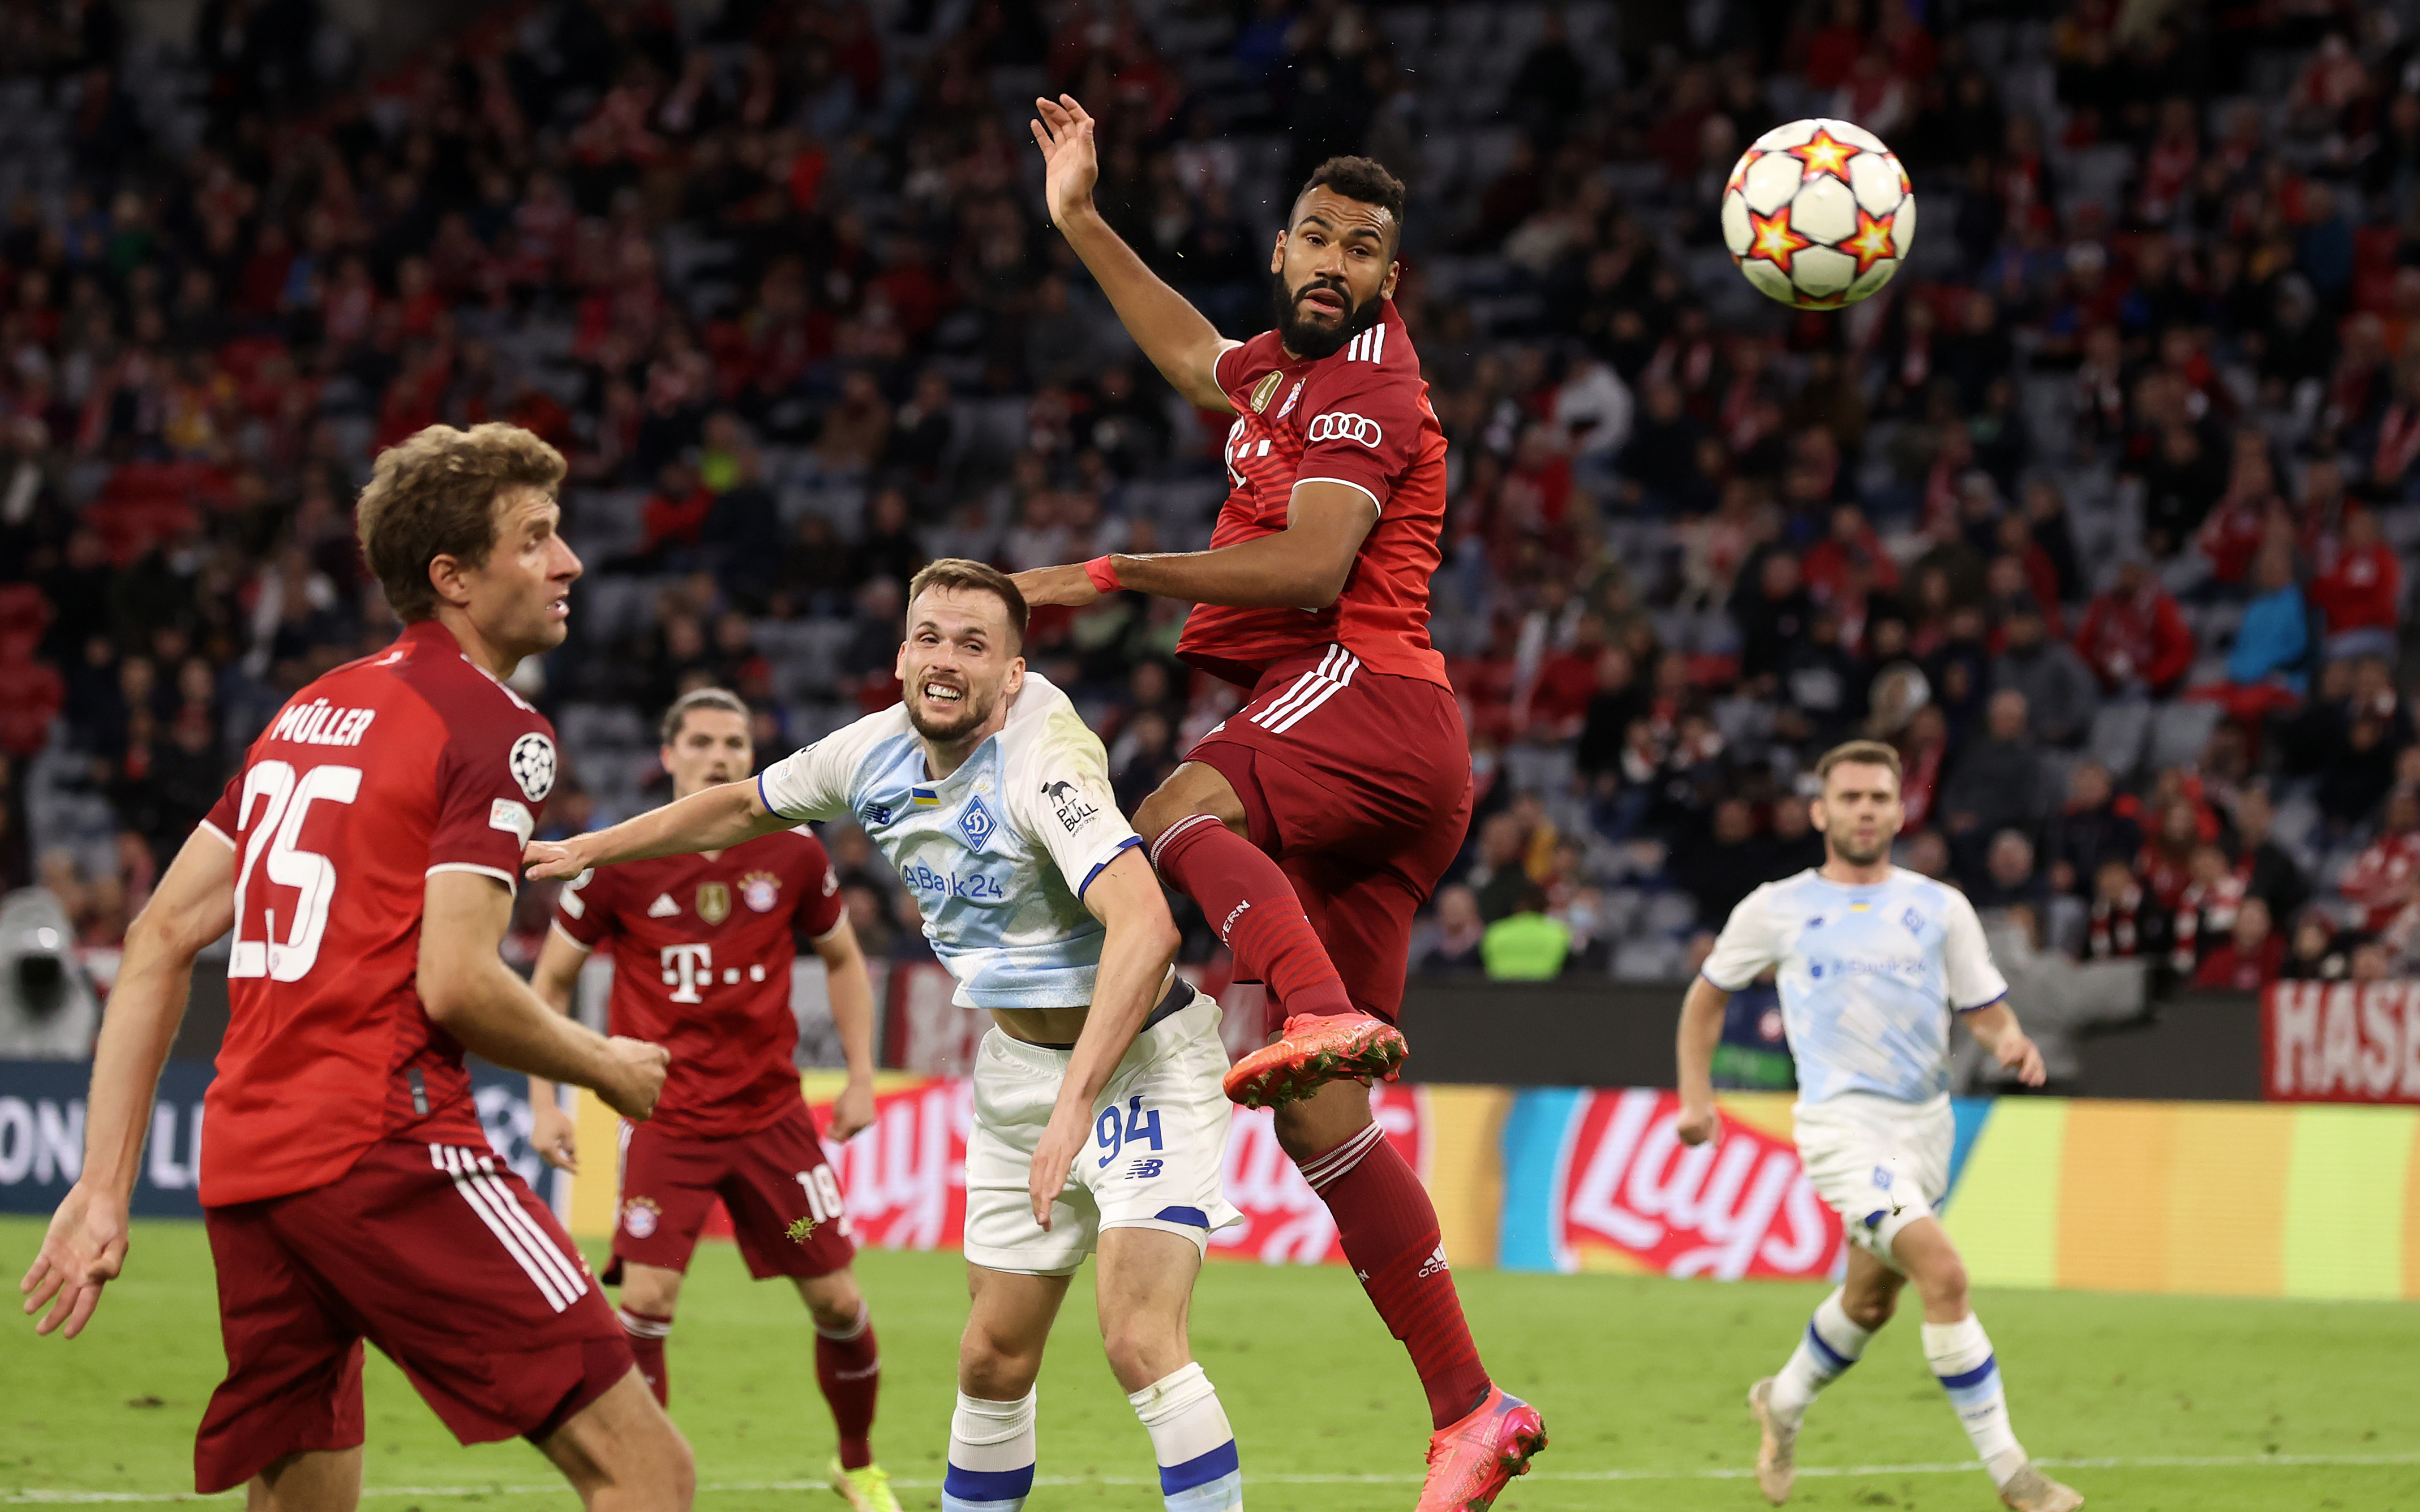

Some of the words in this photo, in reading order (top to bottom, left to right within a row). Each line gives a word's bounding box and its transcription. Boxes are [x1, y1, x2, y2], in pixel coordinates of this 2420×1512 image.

[270, 697, 376, 746] MÜLLER
[1056, 798, 1076, 822] PIT
[1063, 804, 1099, 832] BULL
[227, 759, 364, 983] 25
[1097, 1095, 1162, 1168] 94
[795, 1163, 843, 1223] 18
[1419, 1260, 1449, 1278] adid
